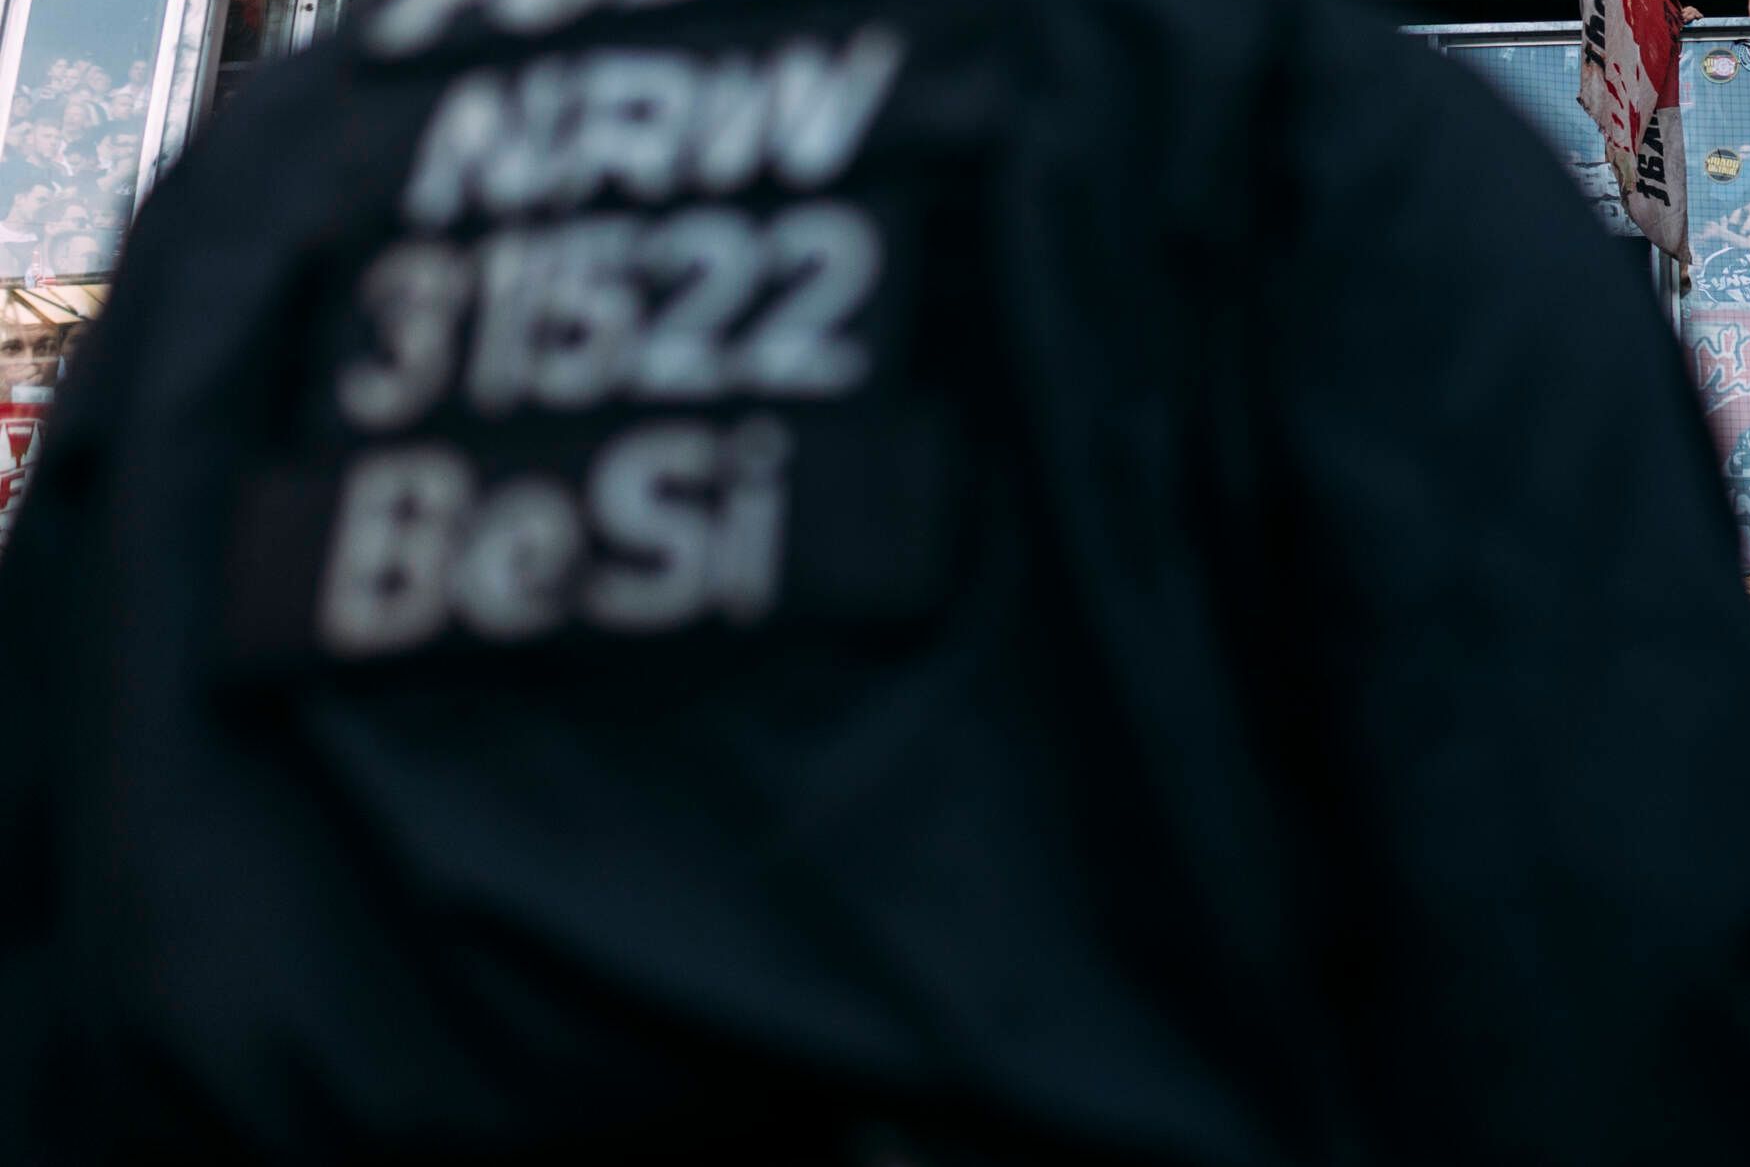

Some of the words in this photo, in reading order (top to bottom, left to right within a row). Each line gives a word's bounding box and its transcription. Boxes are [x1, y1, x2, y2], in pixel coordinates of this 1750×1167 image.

[402, 25, 906, 228] NRW
[336, 200, 887, 431] 31522
[316, 411, 789, 657] BeSi
